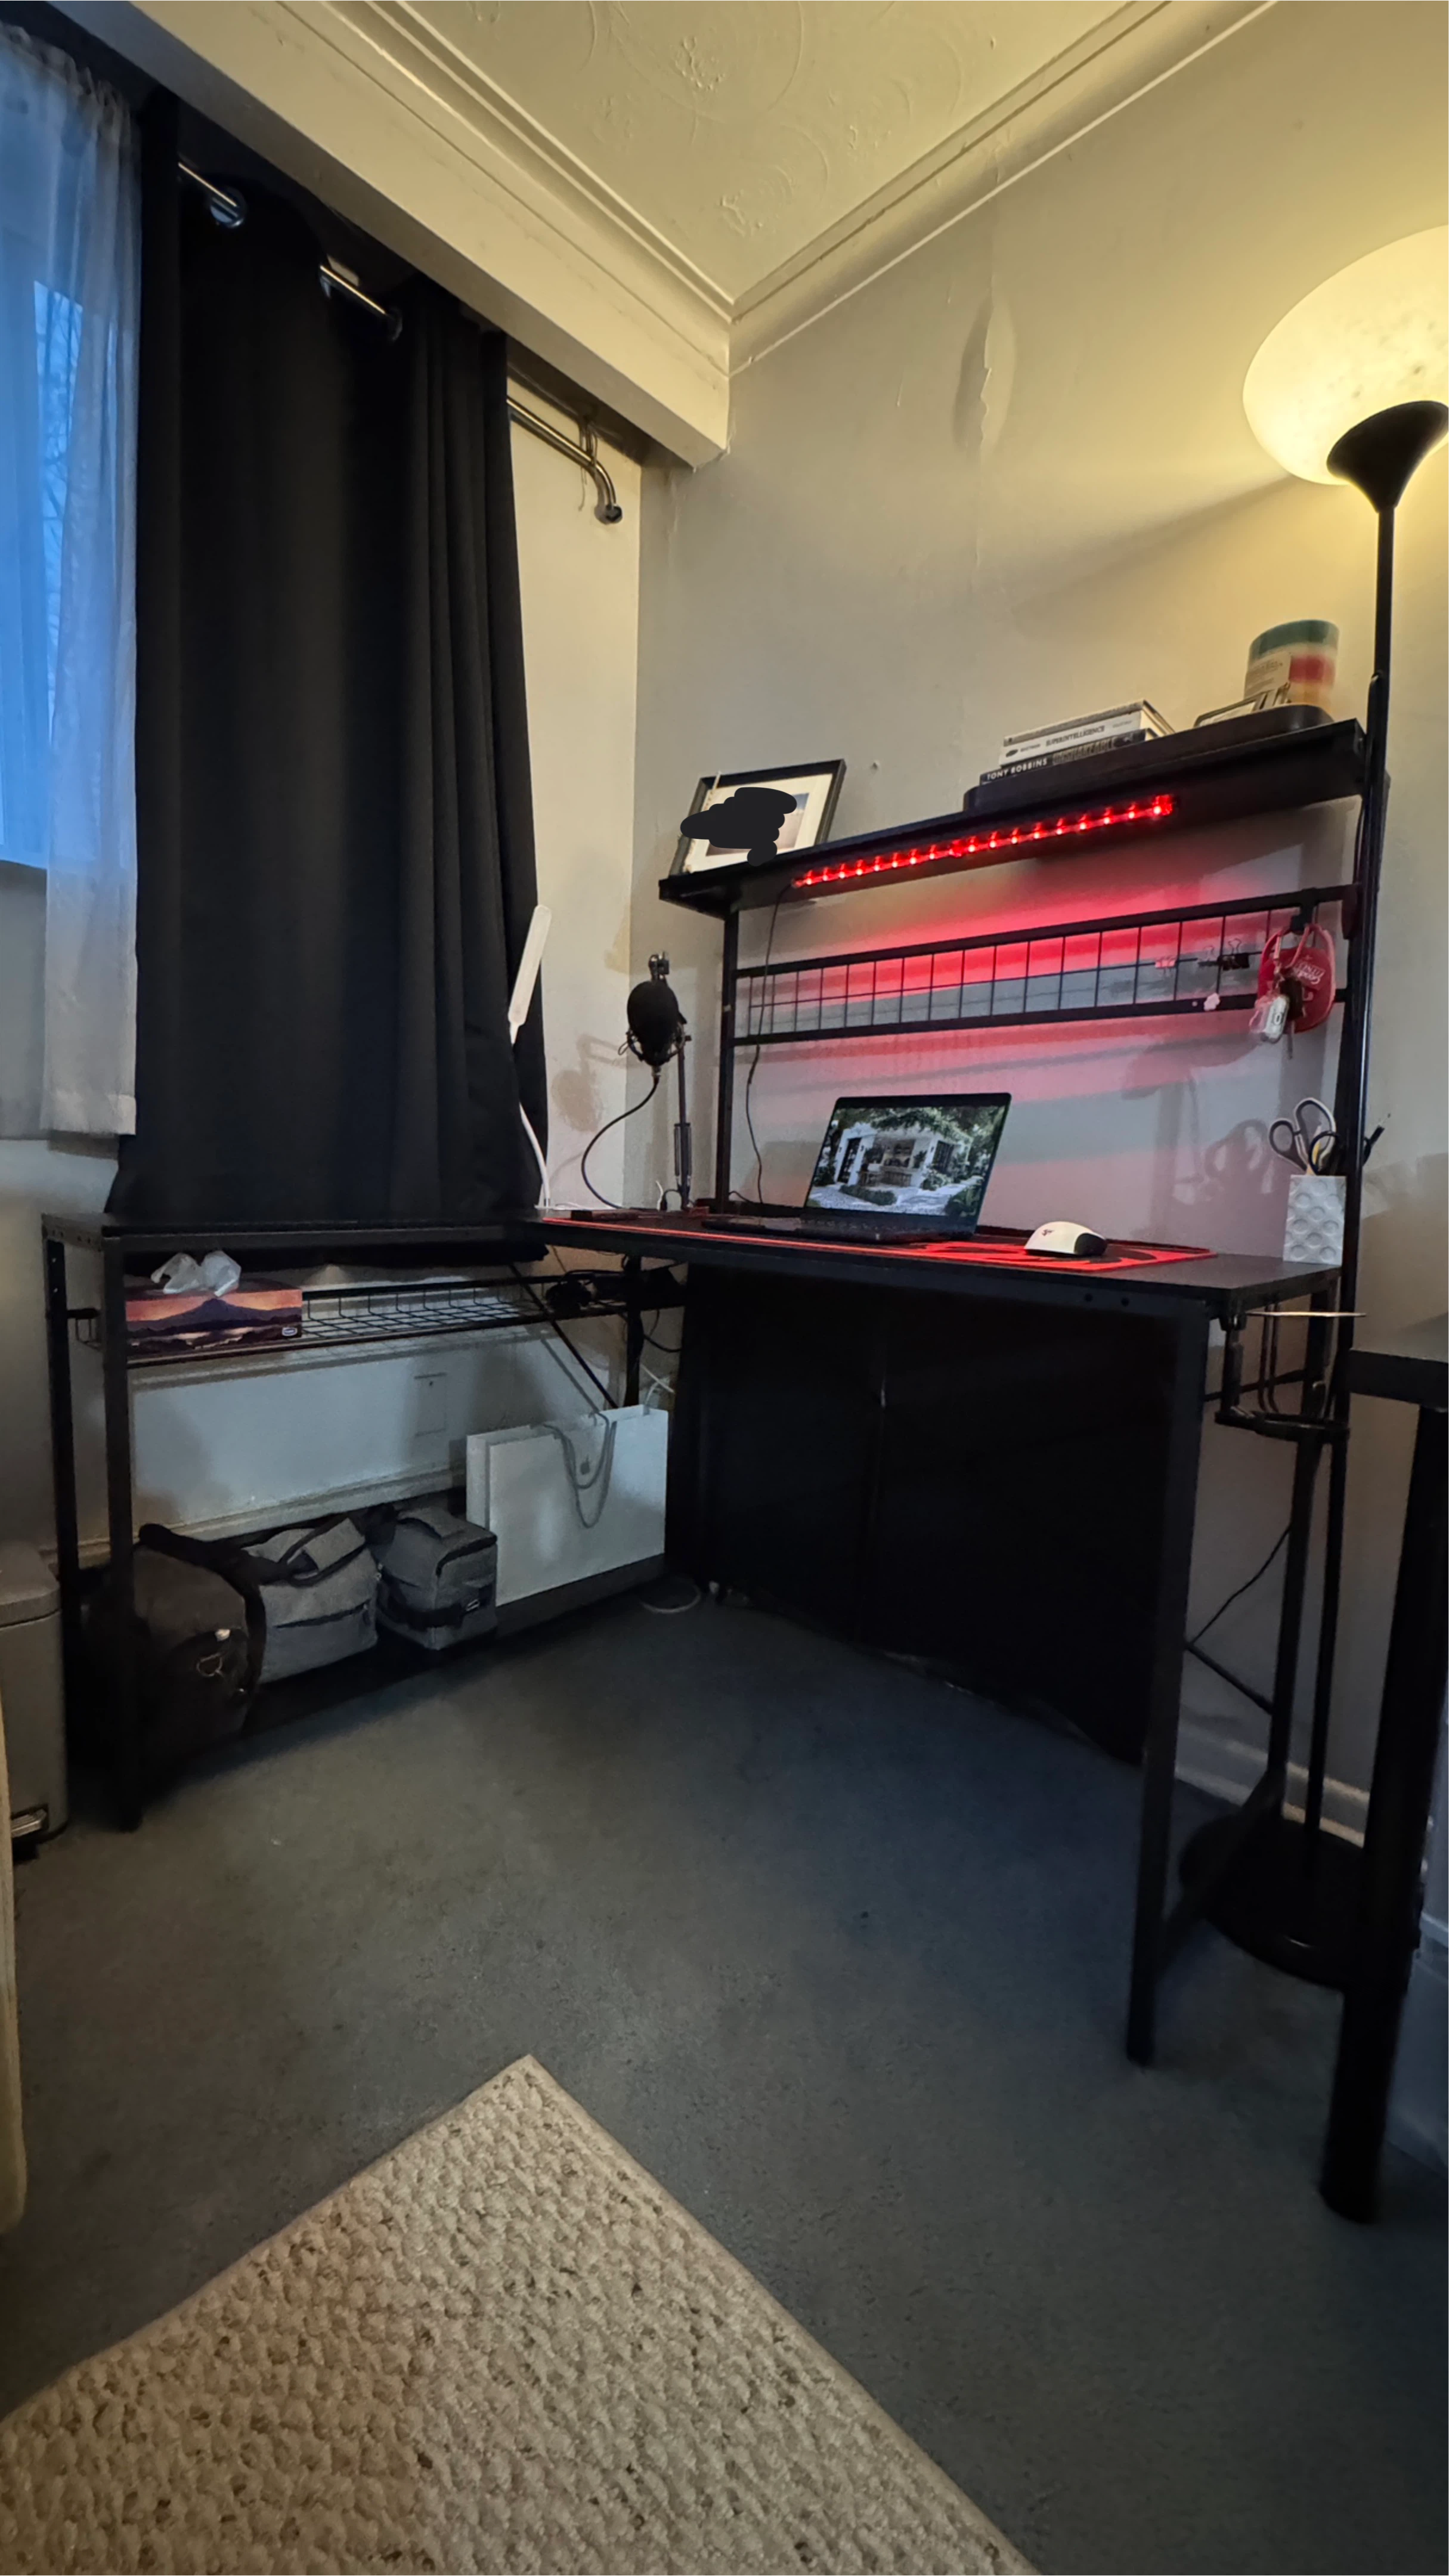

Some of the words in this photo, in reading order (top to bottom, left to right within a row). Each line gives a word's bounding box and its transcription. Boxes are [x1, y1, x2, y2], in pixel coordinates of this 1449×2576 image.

[1045, 725, 1106, 747] SUPERINTELLIGENCE
[987, 769, 1009, 781] TONY
[1011, 757, 1048, 774] ROBBINS
